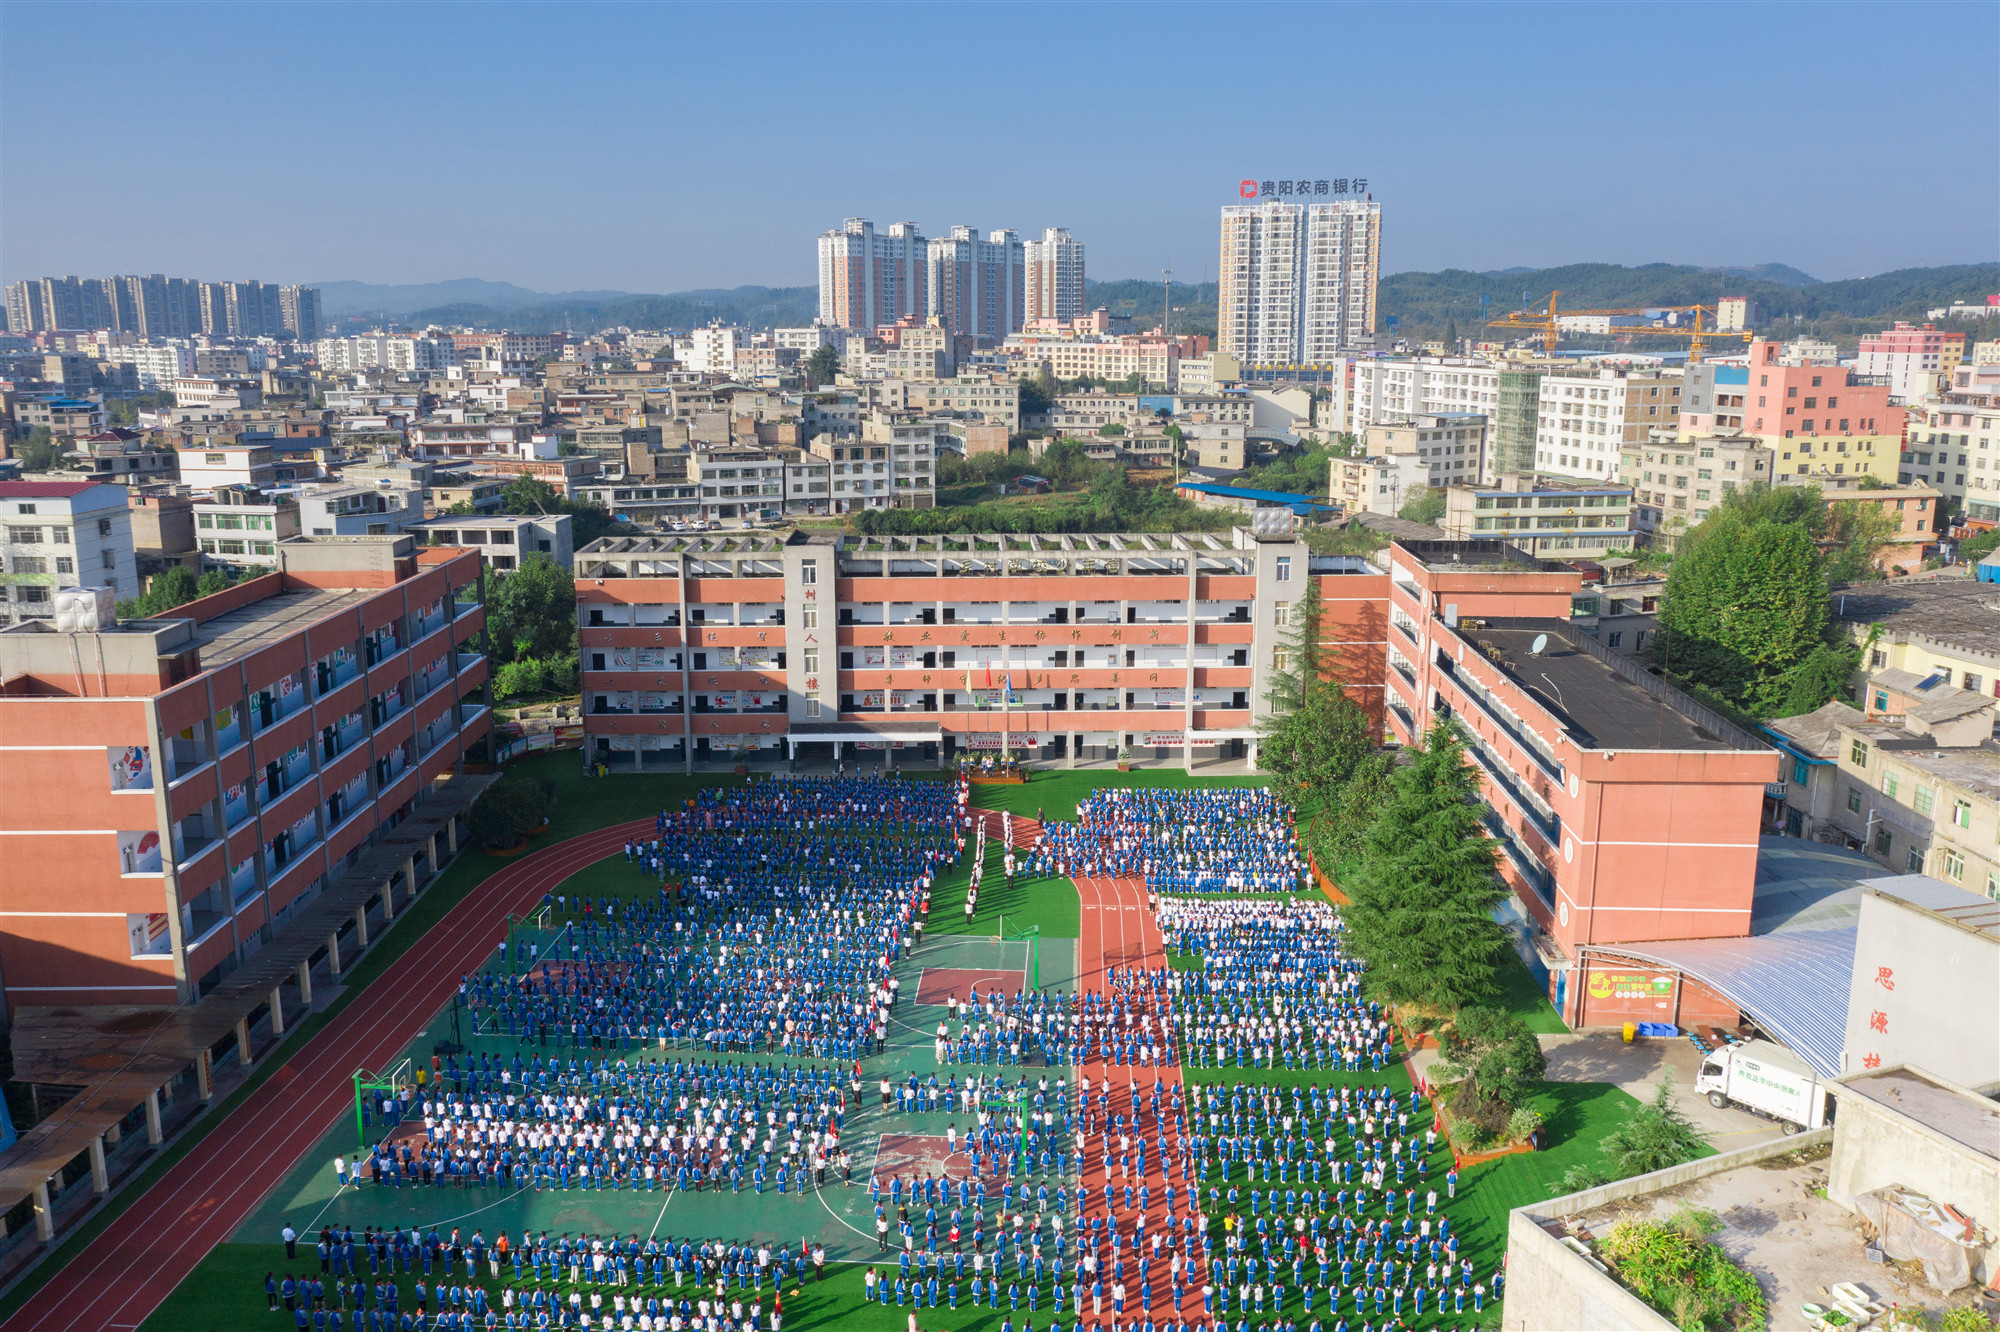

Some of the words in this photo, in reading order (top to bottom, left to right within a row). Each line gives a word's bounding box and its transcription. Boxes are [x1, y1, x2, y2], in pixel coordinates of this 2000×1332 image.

[1260, 178, 1368, 196] 贵阳农商银行
[805, 589, 820, 690] 树人楼
